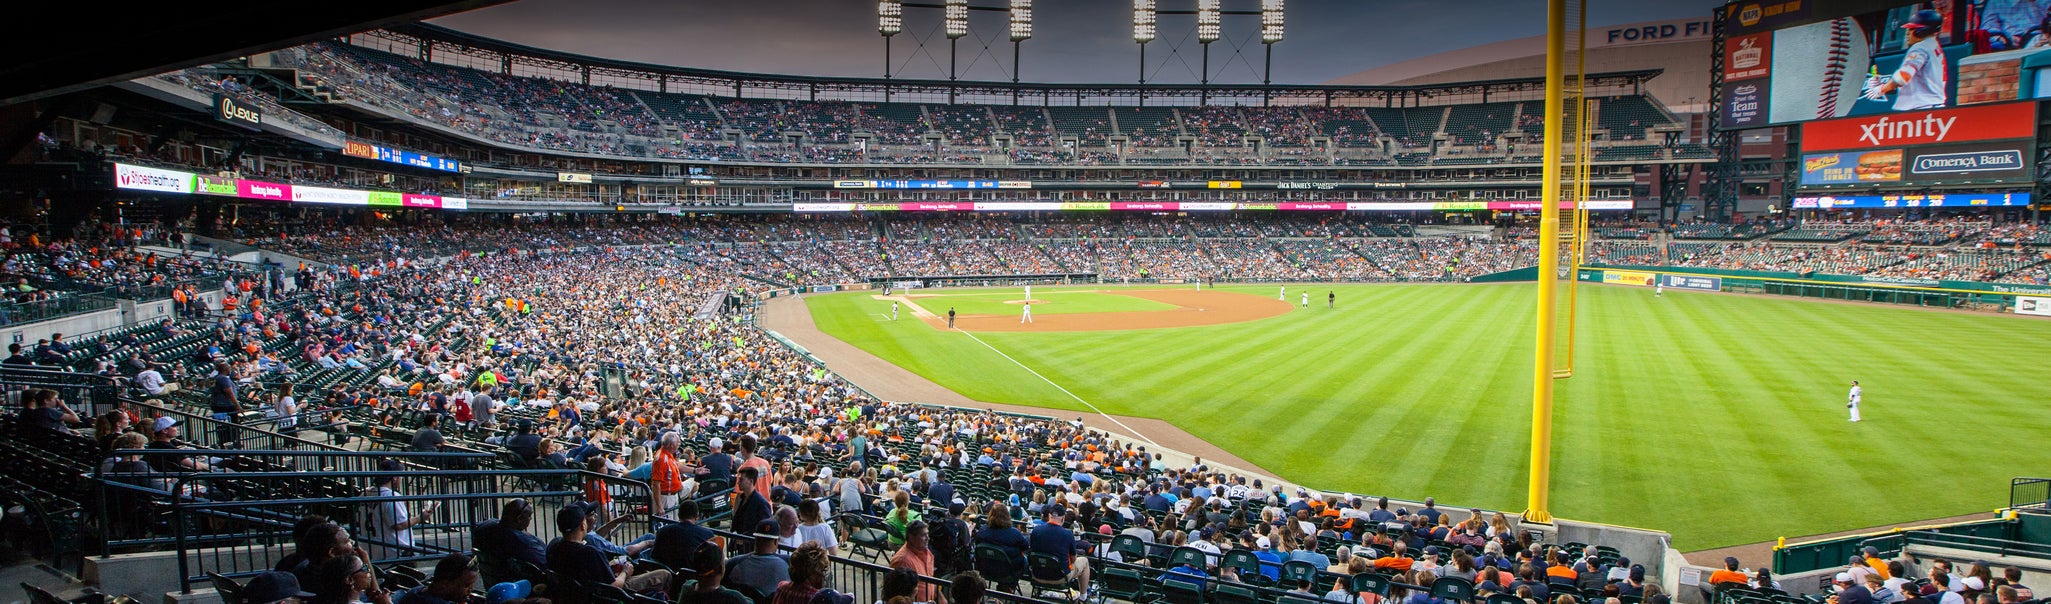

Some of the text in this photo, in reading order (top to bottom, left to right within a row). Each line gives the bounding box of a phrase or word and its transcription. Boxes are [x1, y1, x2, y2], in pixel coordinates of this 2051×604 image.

[1607, 24, 1676, 43] FORD
[1731, 101, 1758, 112] Team
[232, 104, 259, 123] LEXUS
[1859, 113, 1957, 146] xfinity
[347, 142, 370, 157] LIPARI
[1980, 154, 2014, 165] Bank
[1277, 181, 1311, 189] JACK DANIEL'S
[1670, 275, 1687, 287] Lite
[1233, 490, 1245, 498] 24
